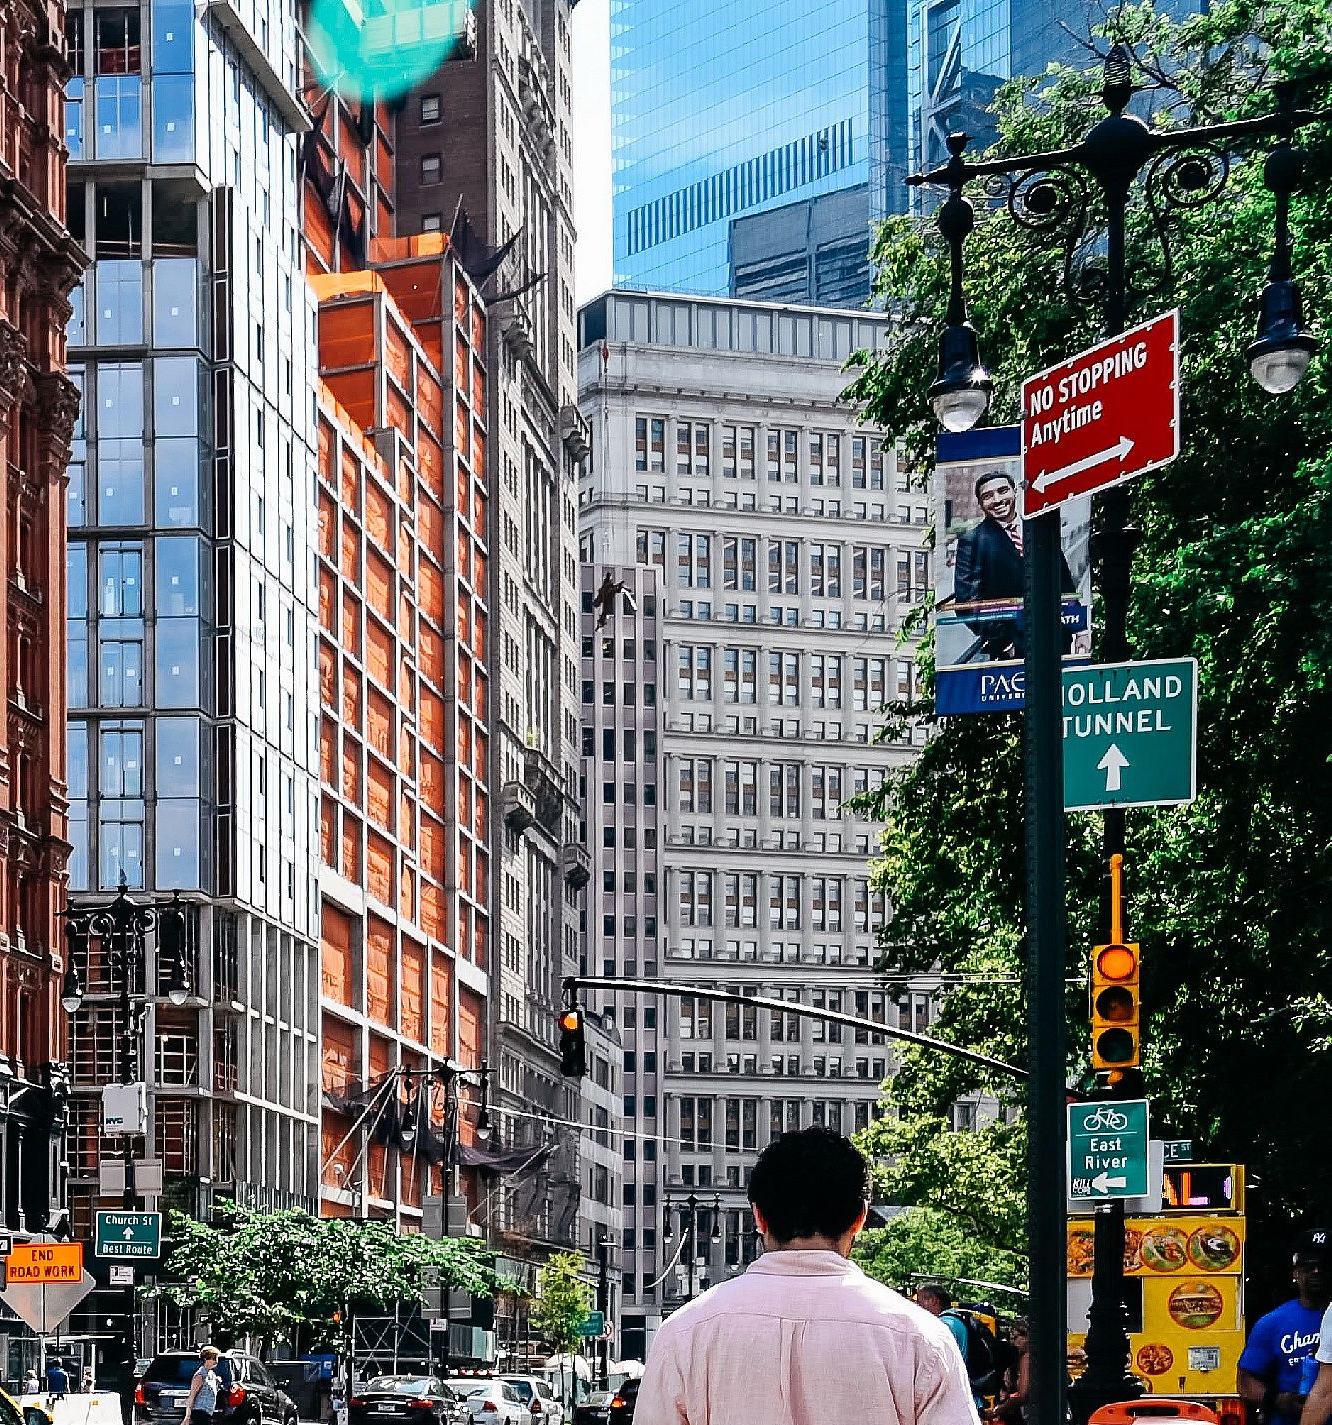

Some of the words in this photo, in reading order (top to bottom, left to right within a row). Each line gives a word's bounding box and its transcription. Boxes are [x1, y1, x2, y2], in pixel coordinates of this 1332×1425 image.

[1030, 385, 1054, 418] NO
[1058, 341, 1148, 403] STOPPING
[1031, 400, 1102, 449] Anytime
[1062, 675, 1182, 707] OLLAND
[1062, 709, 1173, 739] TUNNEL
[1090, 1137, 1122, 1152] East
[1085, 1155, 1128, 1170] River
[105, 1215, 139, 1226] Church
[142, 1215, 153, 1226] St
[31, 1249, 54, 1262] END
[102, 1243, 123, 1254] Best
[125, 1243, 153, 1255] Route
[9, 1265, 41, 1278] ROAD
[44, 1264, 75, 1278] WORK
